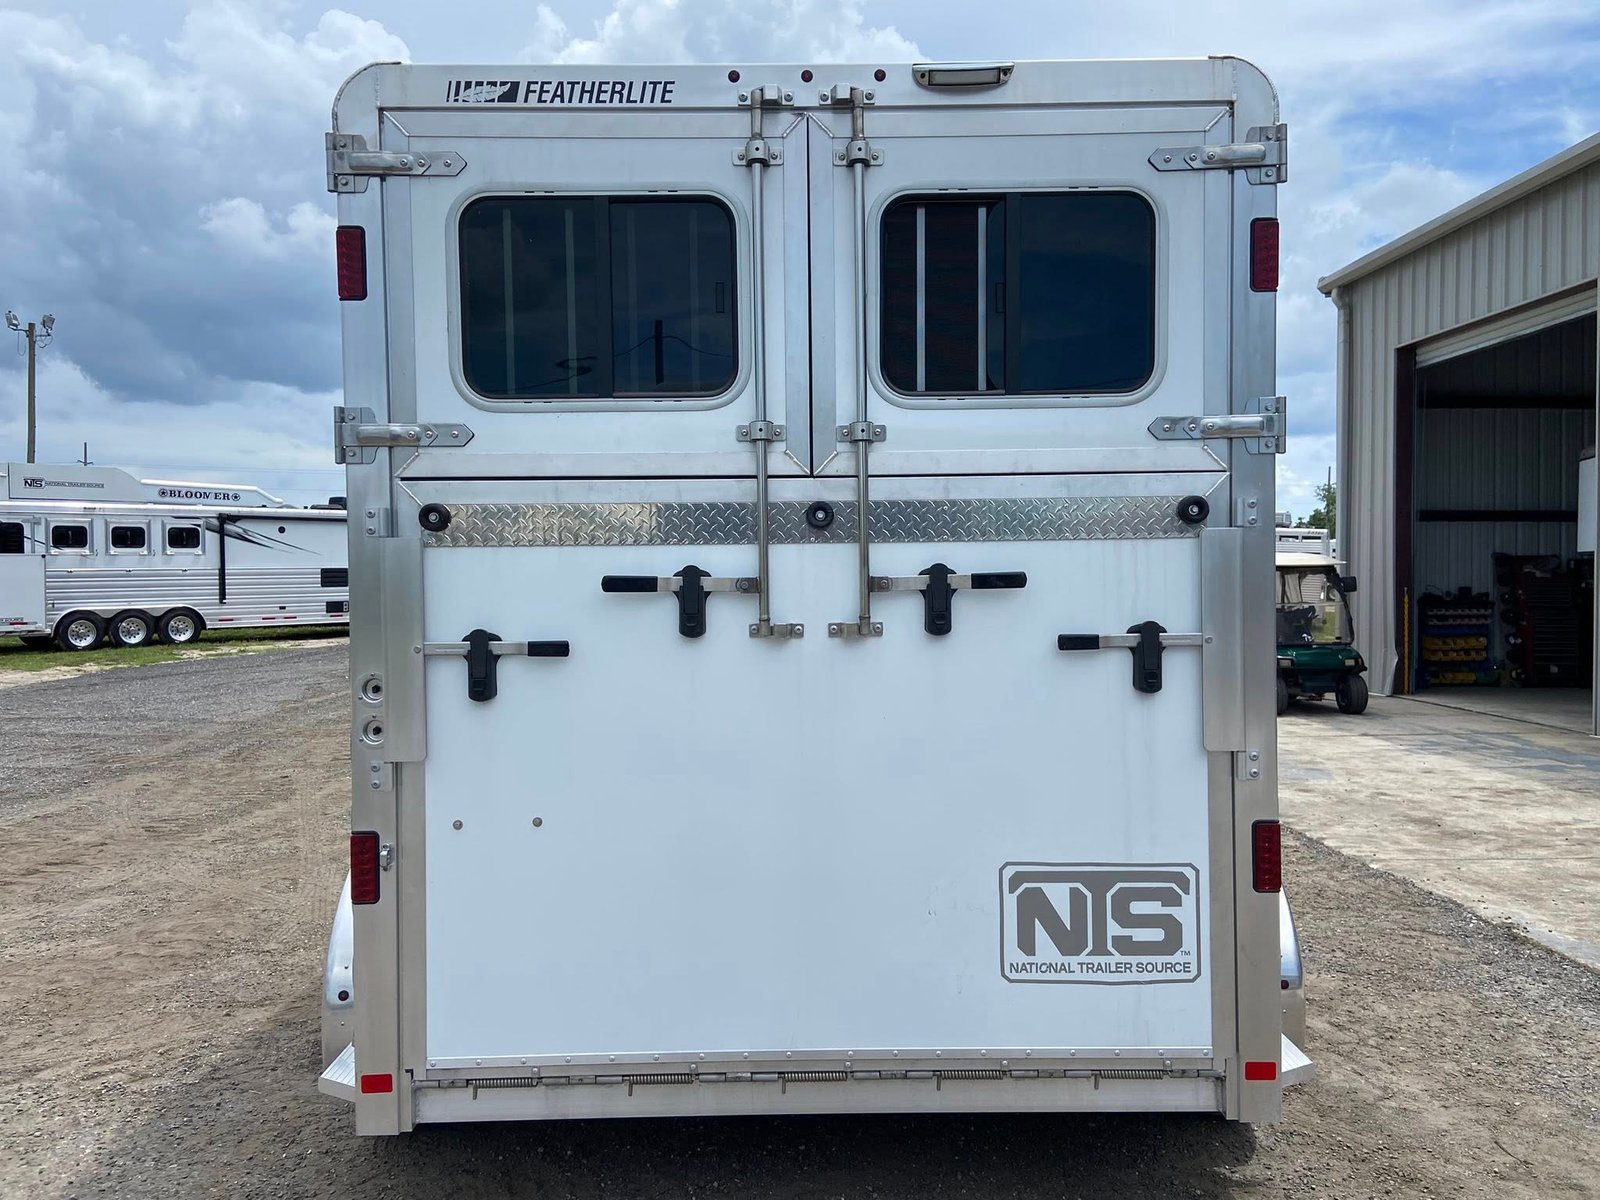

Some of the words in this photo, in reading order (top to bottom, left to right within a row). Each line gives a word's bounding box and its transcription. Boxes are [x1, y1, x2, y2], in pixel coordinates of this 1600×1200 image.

[524, 80, 676, 104] FEATHERLITE
[23, 478, 44, 488] NTS
[1008, 870, 1191, 957] NTS
[1009, 961, 1076, 975] NATIONAL
[1077, 961, 1133, 974] TRAILER
[1135, 961, 1192, 974] SOURCE
